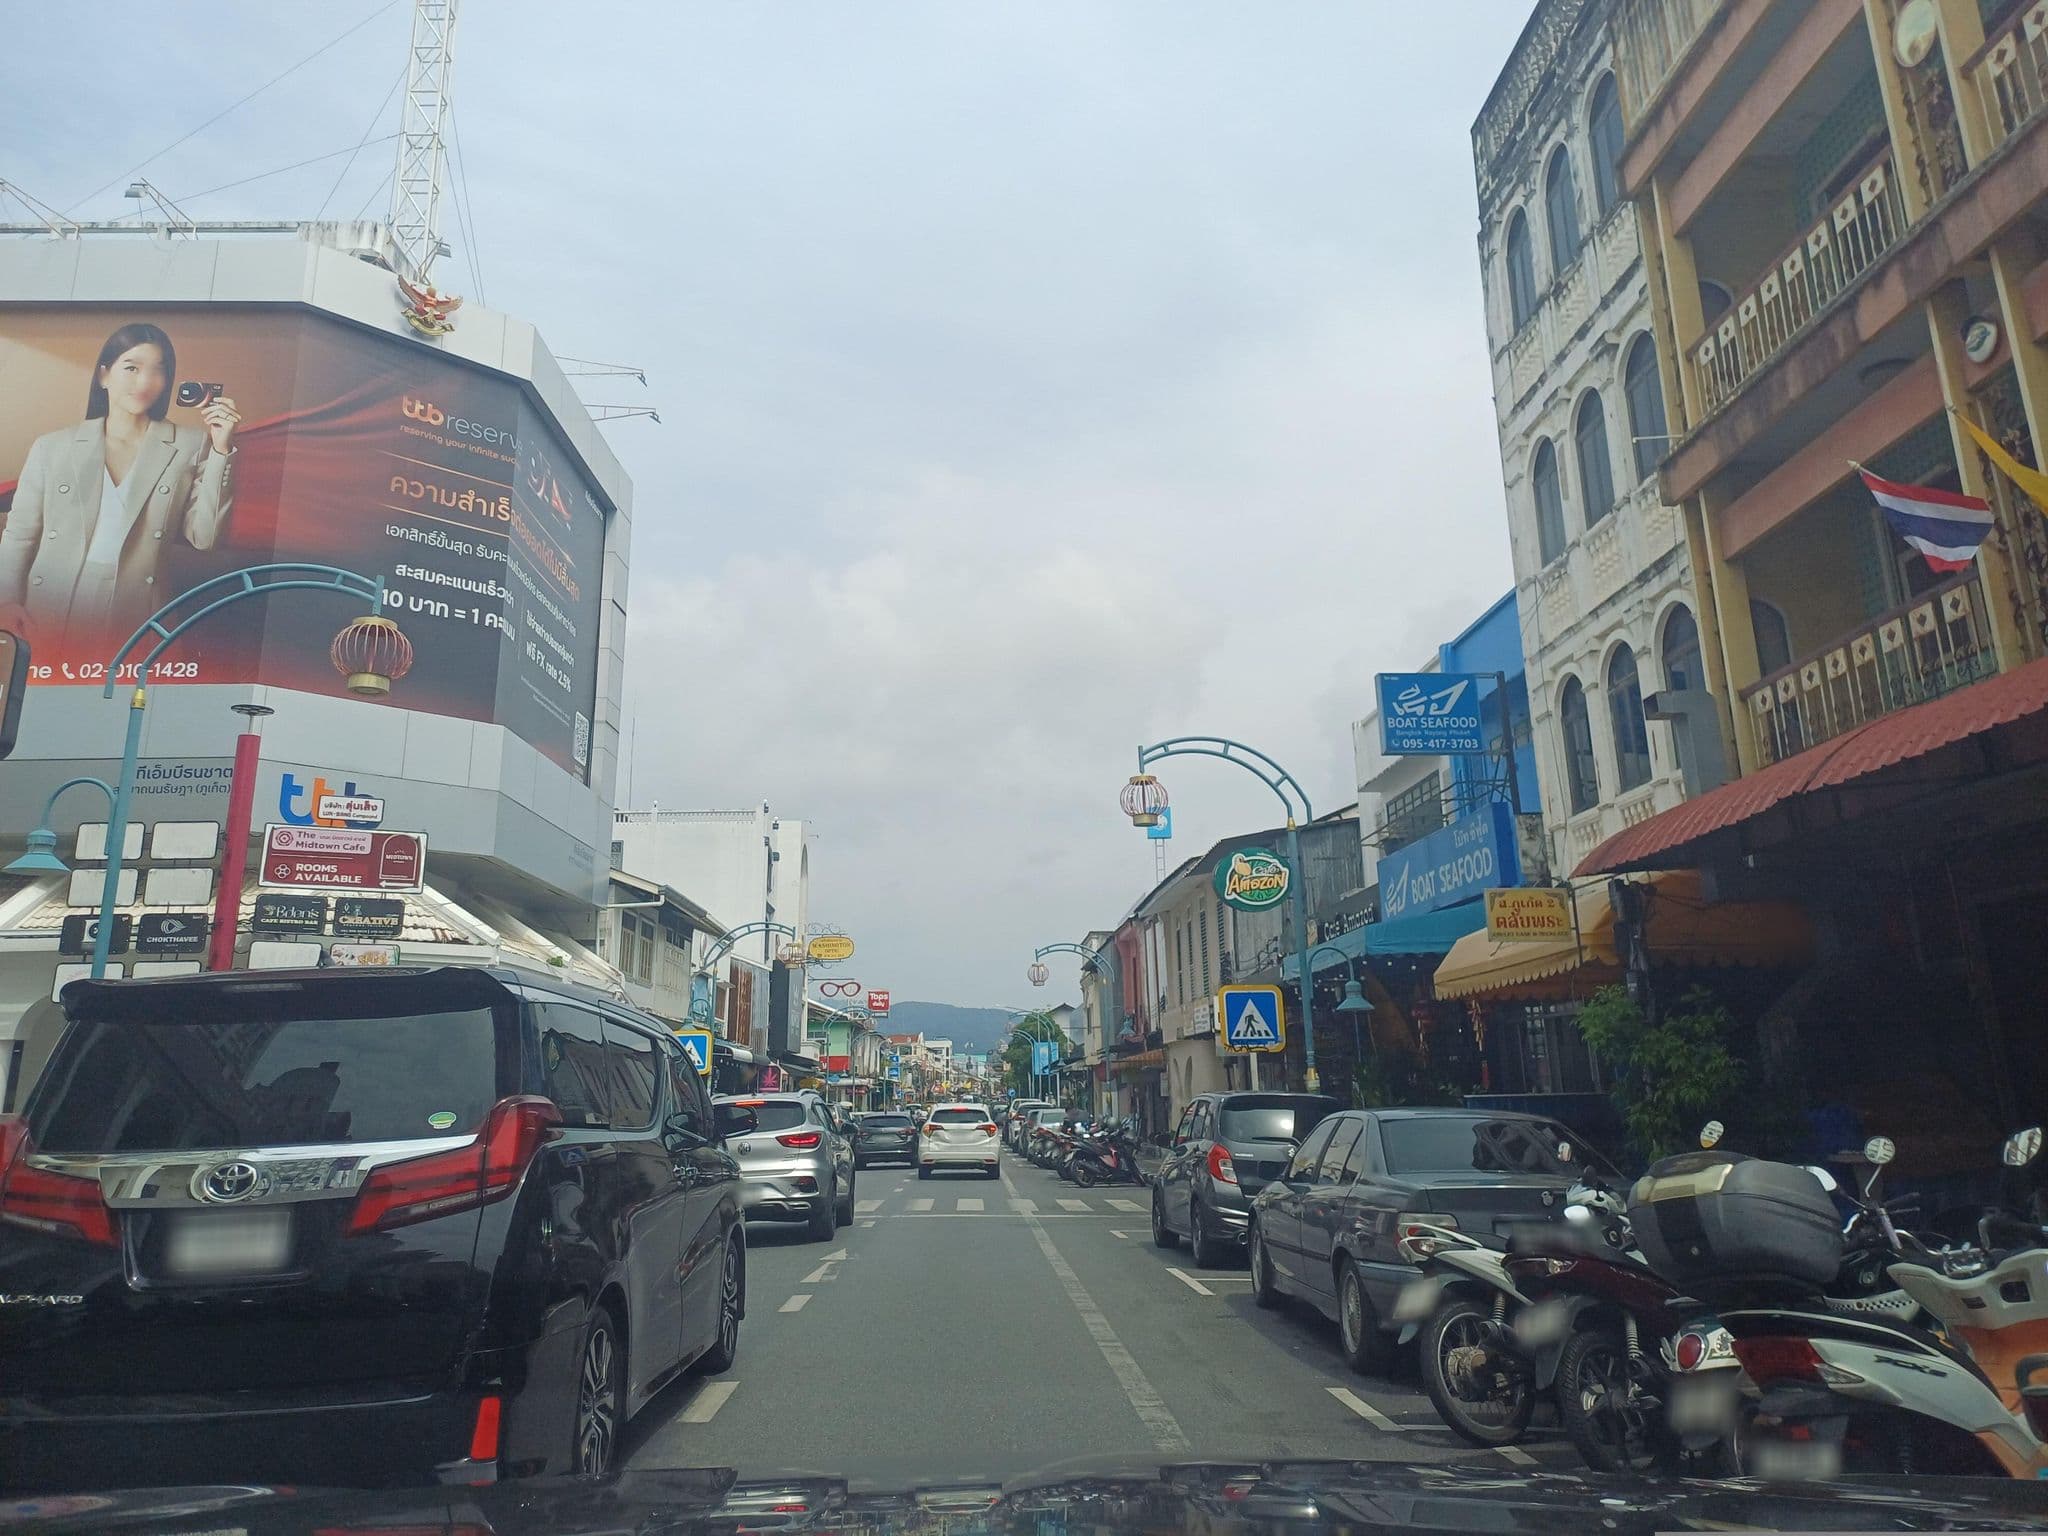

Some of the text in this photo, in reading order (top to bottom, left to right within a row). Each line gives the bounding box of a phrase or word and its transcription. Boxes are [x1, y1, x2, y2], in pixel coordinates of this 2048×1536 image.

[400, 424, 443, 446] reserving
[445, 439, 466, 449] your
[468, 444, 500, 460] infinite
[381, 589, 403, 608] 10
[409, 596, 449, 618] บาท
[471, 609, 480, 625] 1
[535, 655, 546, 670] FX
[545, 662, 558, 681] rate
[1388, 717, 1478, 729] BOAT SEAFOOD
[1402, 738, 1479, 749] 095-417-3703
[279, 773, 382, 829] ttb
[297, 831, 316, 839] The
[295, 841, 340, 850] Midtown
[296, 863, 338, 873] ROOMS
[295, 873, 362, 884] AVAILABLE
[1411, 847, 1493, 905] BOAT SEAFOOD
[1547, 900, 1555, 908] 2
